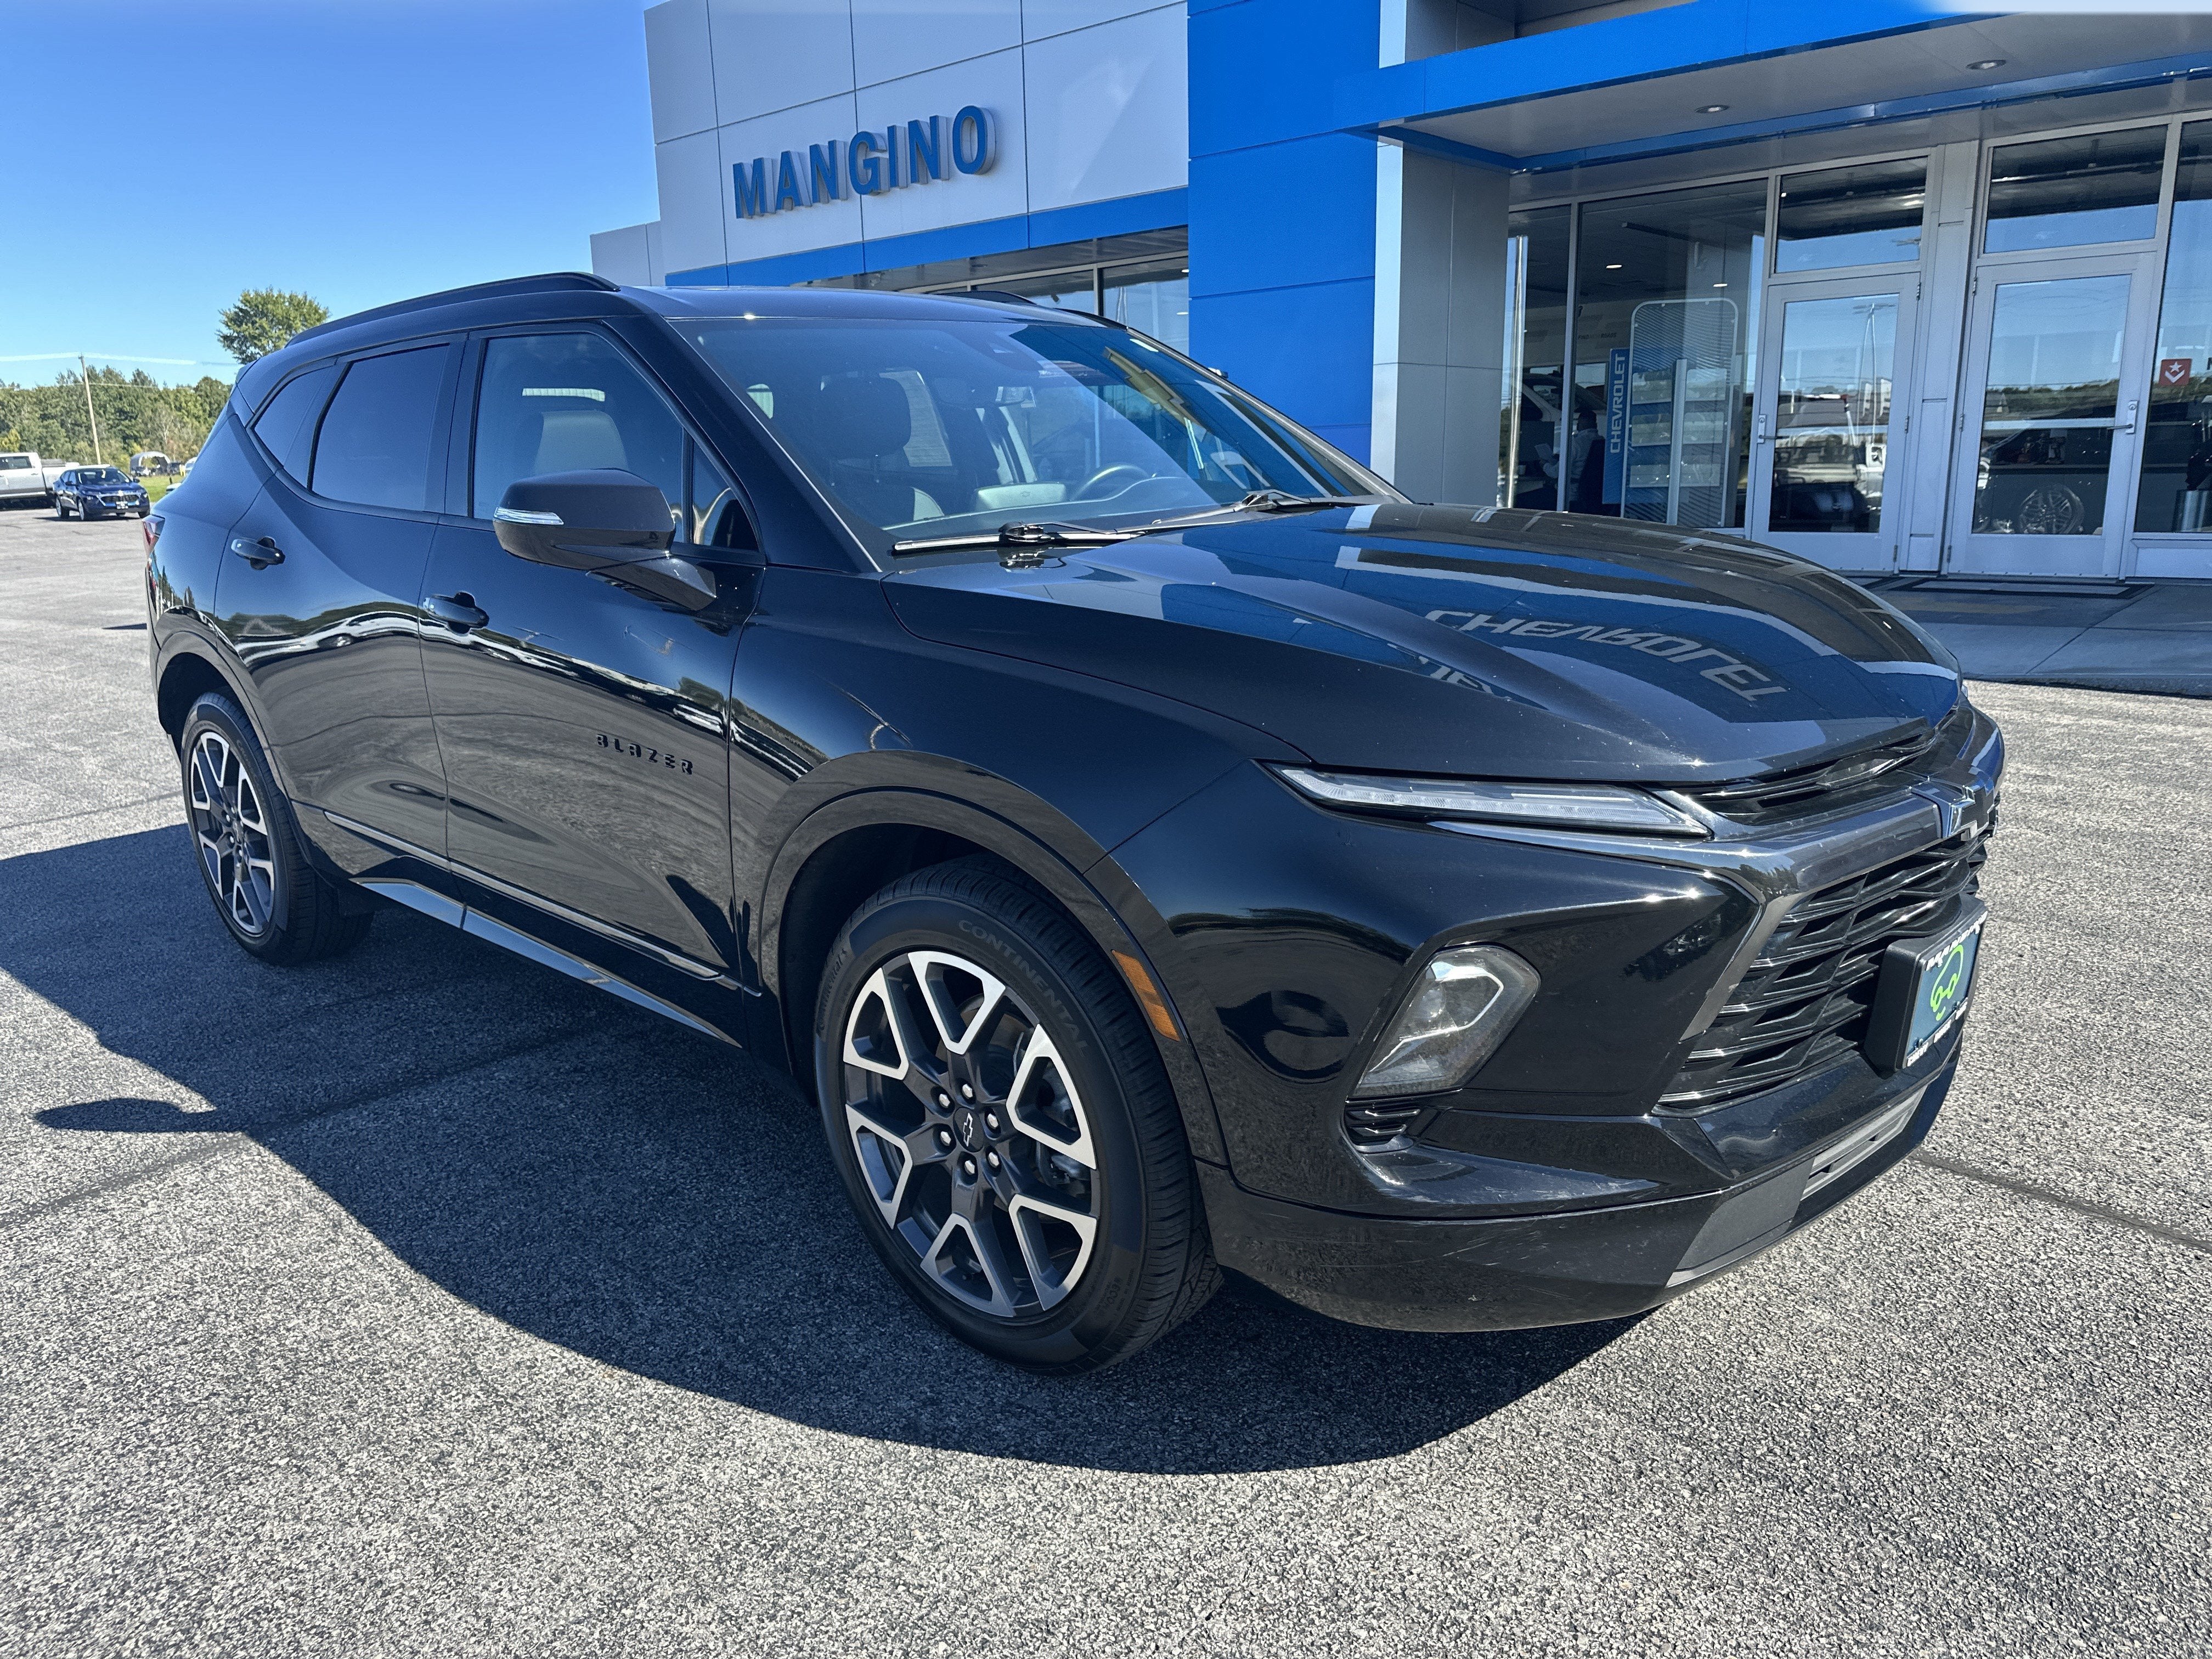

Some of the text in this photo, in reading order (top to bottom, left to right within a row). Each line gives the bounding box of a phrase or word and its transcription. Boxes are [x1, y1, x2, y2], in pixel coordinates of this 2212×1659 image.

[732, 105, 994, 219] MANGINO
[1610, 353, 1626, 454] CHEVROLET
[596, 733, 693, 775] BLAZER
[958, 919, 1090, 1058] CONTINENTAL
